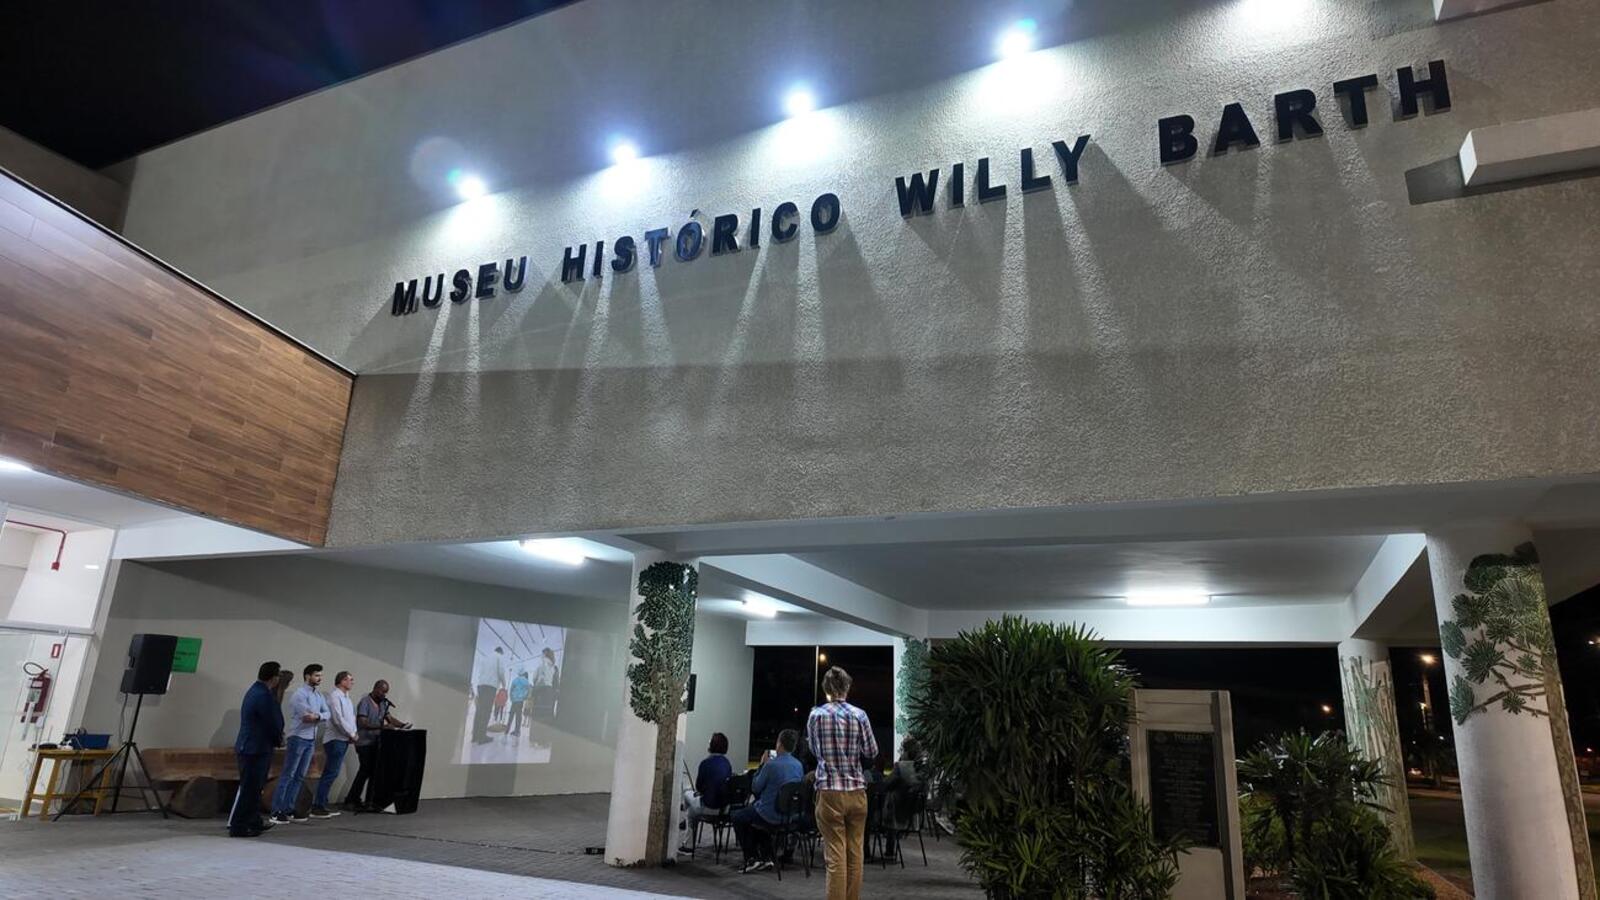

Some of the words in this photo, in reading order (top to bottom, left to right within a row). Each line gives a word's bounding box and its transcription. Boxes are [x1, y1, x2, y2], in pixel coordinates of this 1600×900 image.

[391, 255, 529, 316] MUSEU
[561, 192, 842, 283] HISTÓRICO
[895, 134, 1091, 217] WILLY
[1158, 59, 1452, 165] BARTH
